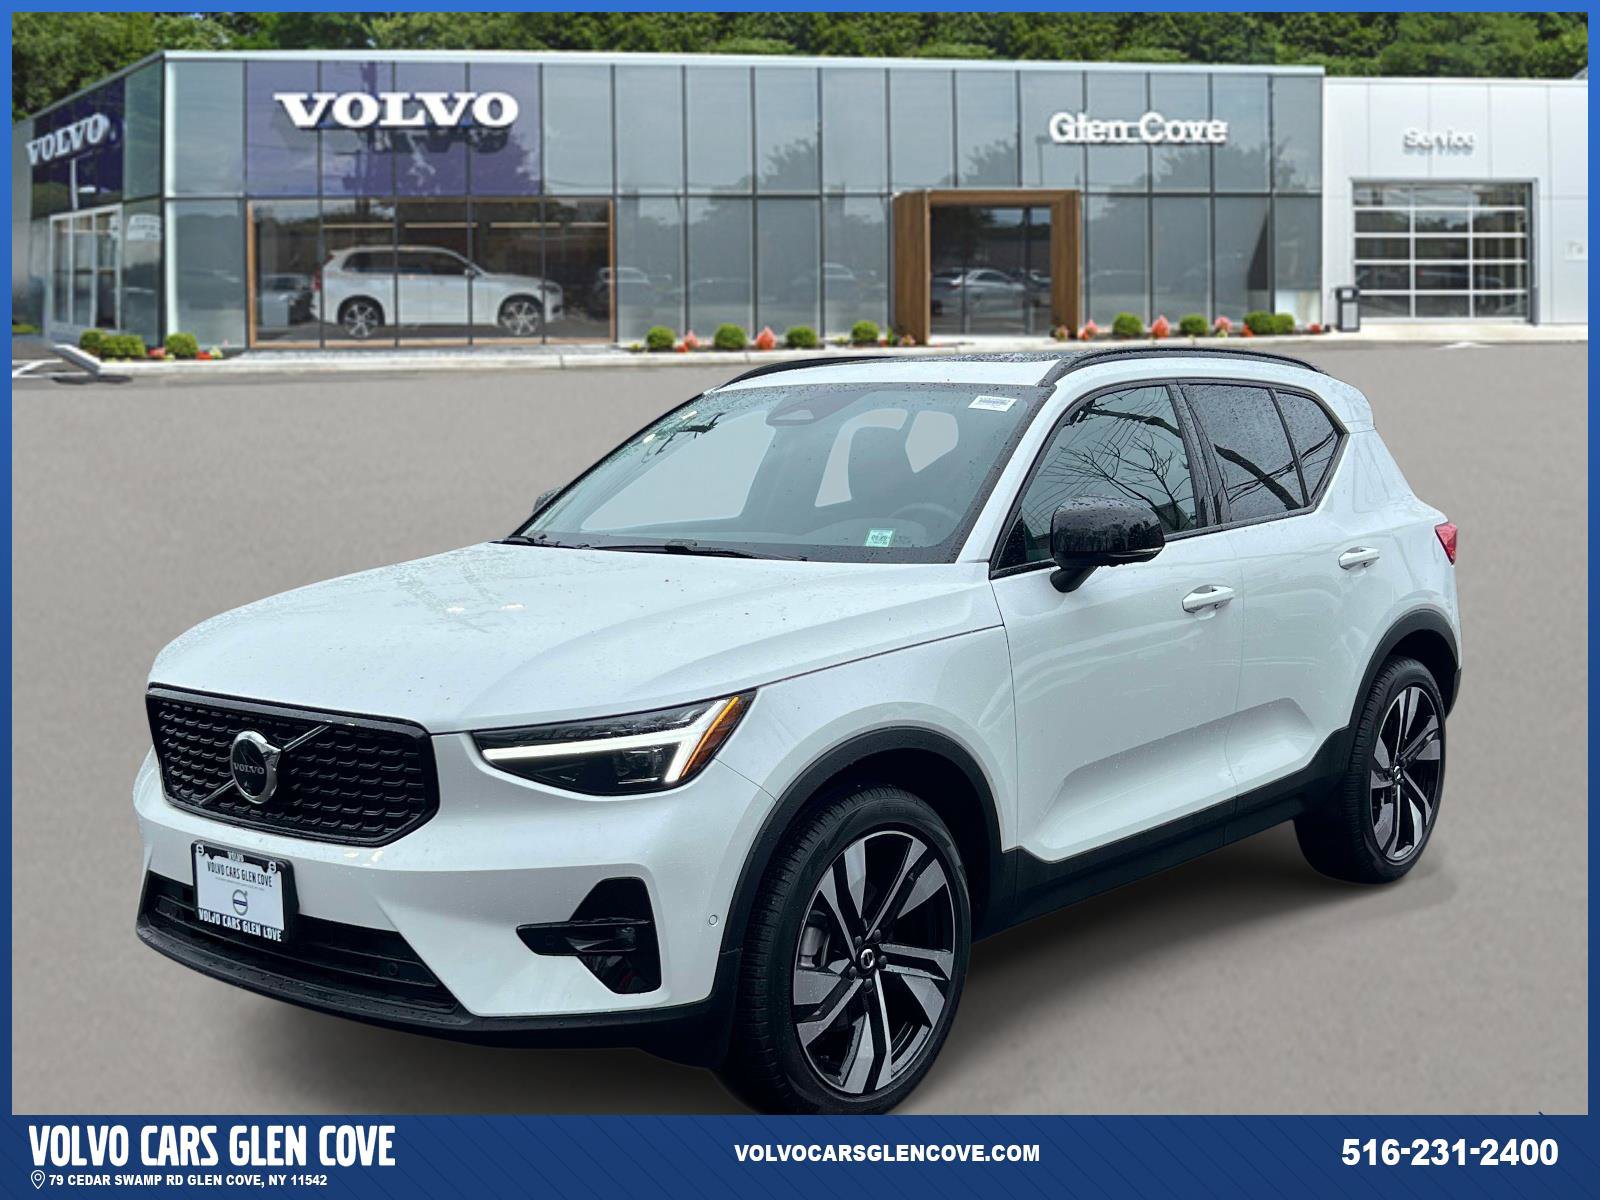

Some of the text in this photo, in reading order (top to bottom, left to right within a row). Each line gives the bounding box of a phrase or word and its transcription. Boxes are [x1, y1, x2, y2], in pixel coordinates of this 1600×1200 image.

[273, 92, 519, 128] VOLVO
[25, 112, 110, 165] VOLVO
[1049, 111, 1228, 144] Glen Cove
[1402, 128, 1475, 151] Service
[233, 762, 265, 775] VOLVO
[207, 861, 225, 876] VOLVO
[226, 865, 240, 880] CARS
[241, 869, 257, 884] GLEN
[258, 873, 272, 888] COVE
[199, 908, 282, 942] VOLVO CARS GLEN COVE
